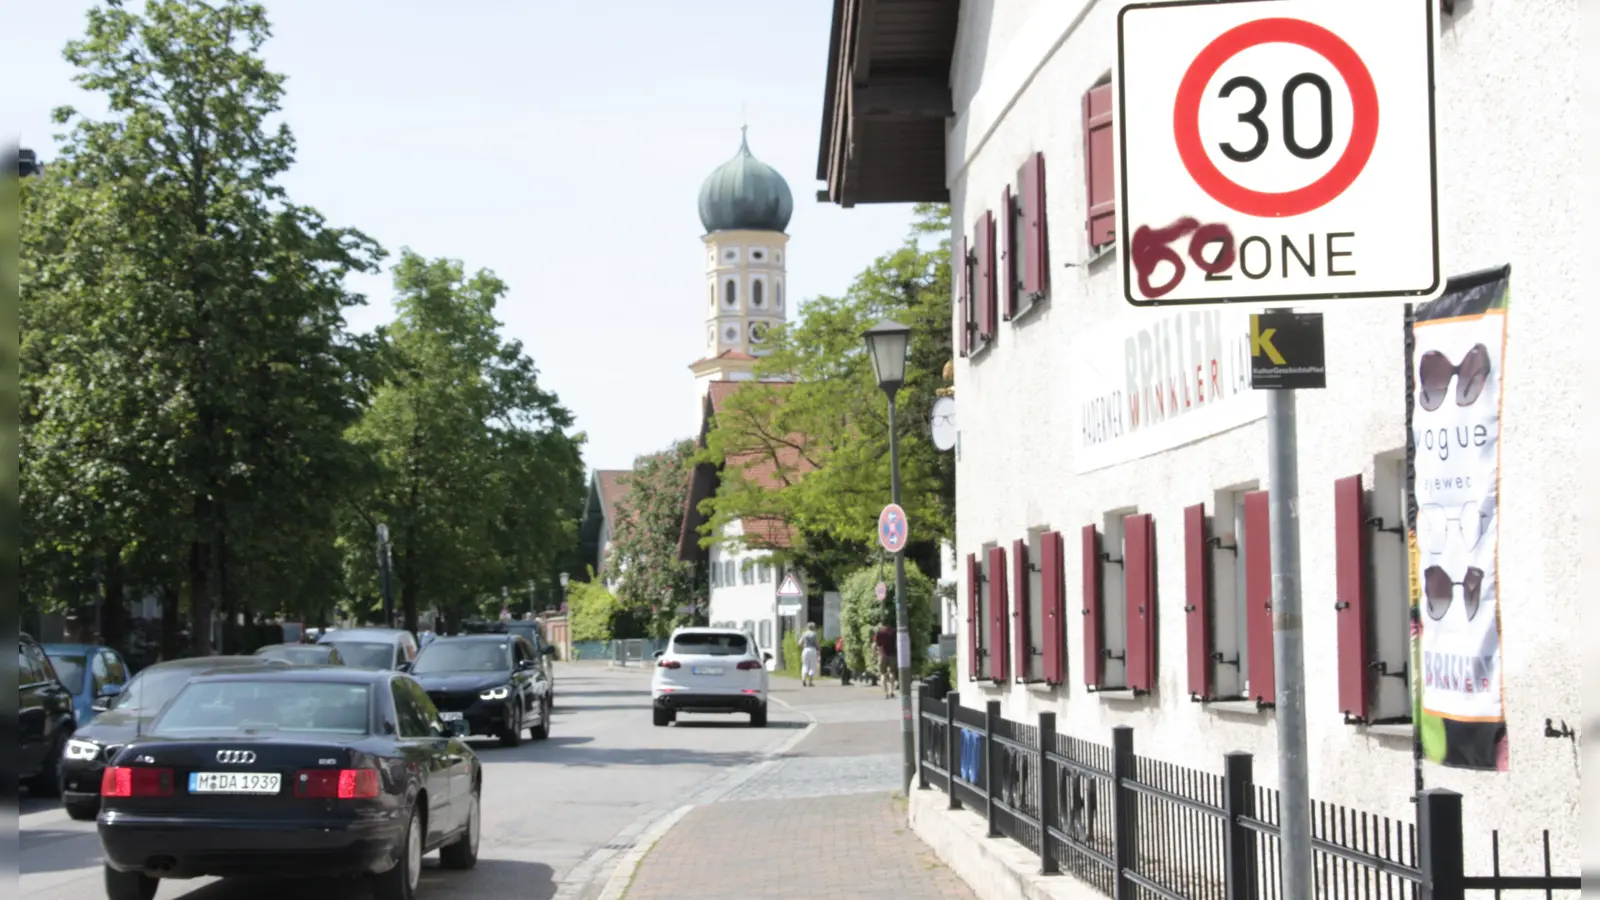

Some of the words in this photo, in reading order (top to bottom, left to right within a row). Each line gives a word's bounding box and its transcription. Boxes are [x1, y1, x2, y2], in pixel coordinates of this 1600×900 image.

[1217, 72, 1333, 163] 30
[1129, 358, 1220, 428] WINKLER
[199, 774, 209, 789] M
[219, 774, 237, 788] DA
[242, 774, 279, 789] 1939
